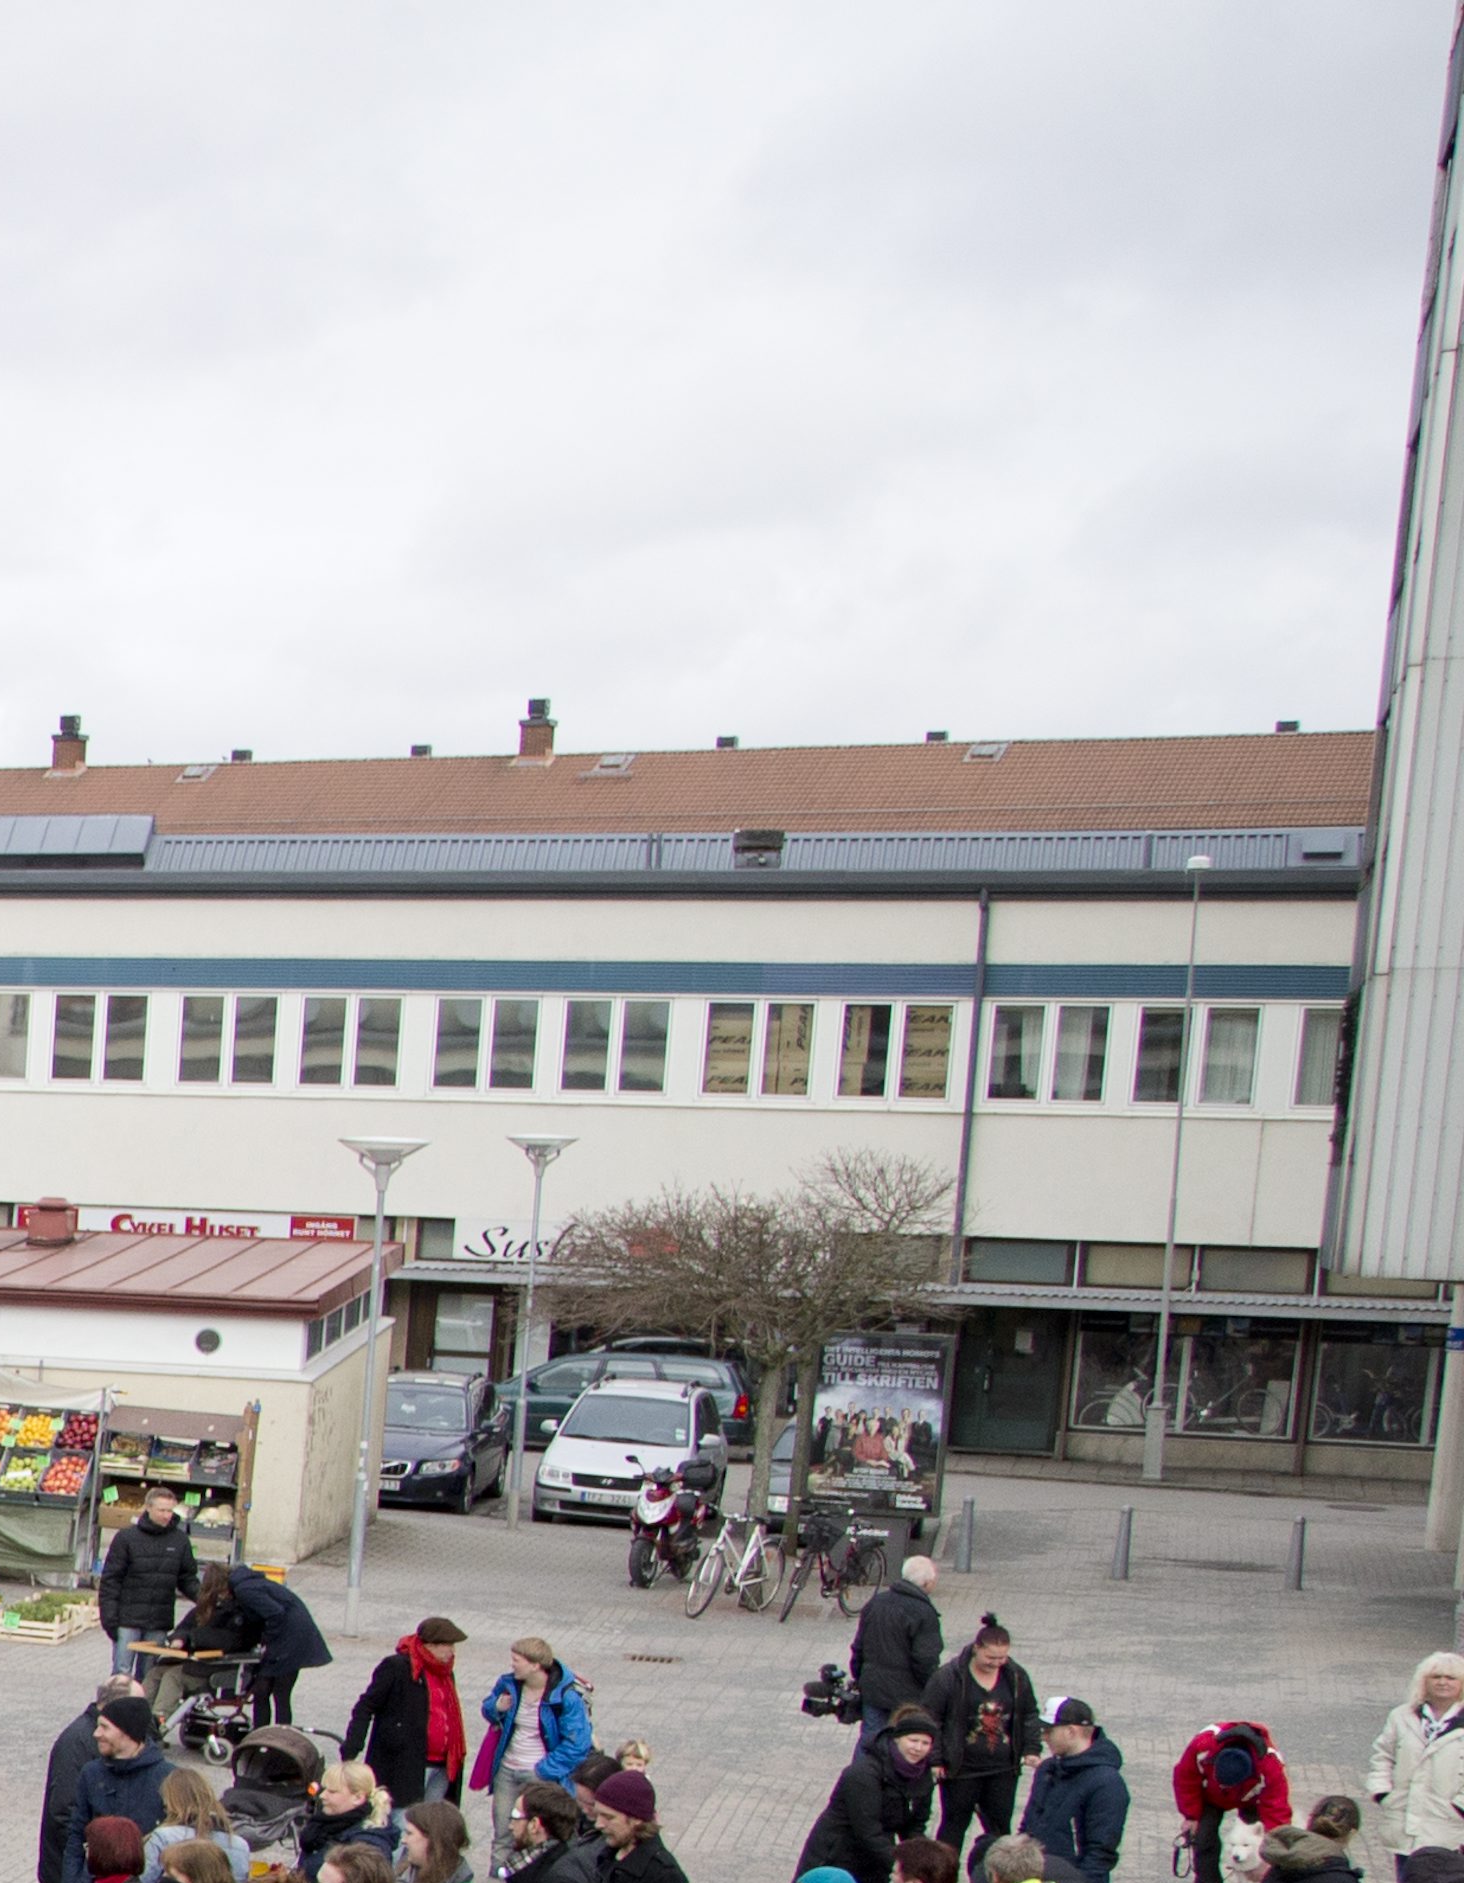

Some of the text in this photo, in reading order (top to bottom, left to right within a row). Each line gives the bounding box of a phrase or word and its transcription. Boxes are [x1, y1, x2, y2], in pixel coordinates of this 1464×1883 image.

[823, 1353, 876, 1367] GUIDE
[822, 1372, 939, 1390] TILL SKRIFTEN
